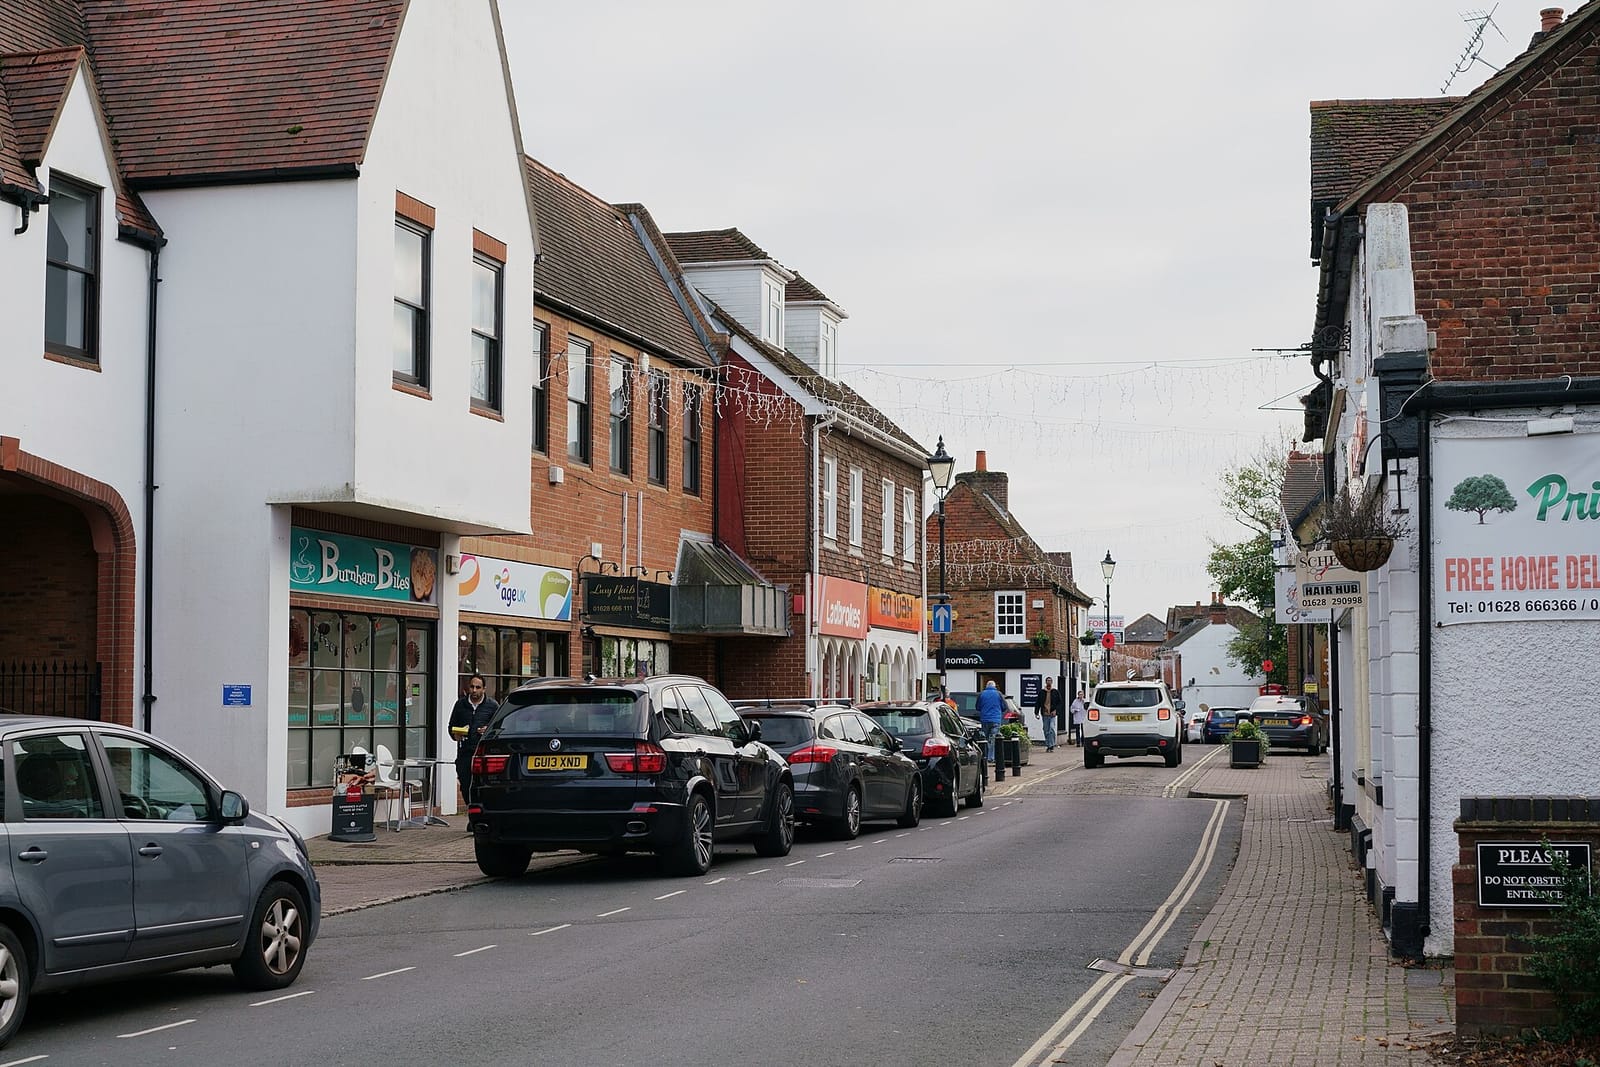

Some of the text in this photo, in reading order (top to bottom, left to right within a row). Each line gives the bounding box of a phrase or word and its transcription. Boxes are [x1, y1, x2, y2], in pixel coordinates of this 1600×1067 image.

[1526, 473, 1600, 522] Pri
[317, 539, 410, 591] Burnham Bites
[1445, 554, 1600, 592] FREE HOME DEL
[613, 584, 636, 594] Nails
[1305, 584, 1358, 596] HAIR HUB
[1302, 597, 1363, 607] 01628 290998
[1448, 602, 1473, 613] Tel:
[1478, 601, 1521, 613] 01628
[1525, 600, 1577, 612] 666366
[826, 599, 861, 629] Ladbrokes
[1088, 620, 1125, 628] FOR ALE
[534, 757, 581, 768] GU13 XND
[1498, 849, 1570, 863] PLEASE!
[1485, 876, 1584, 885] DO NOT OBSTRU
